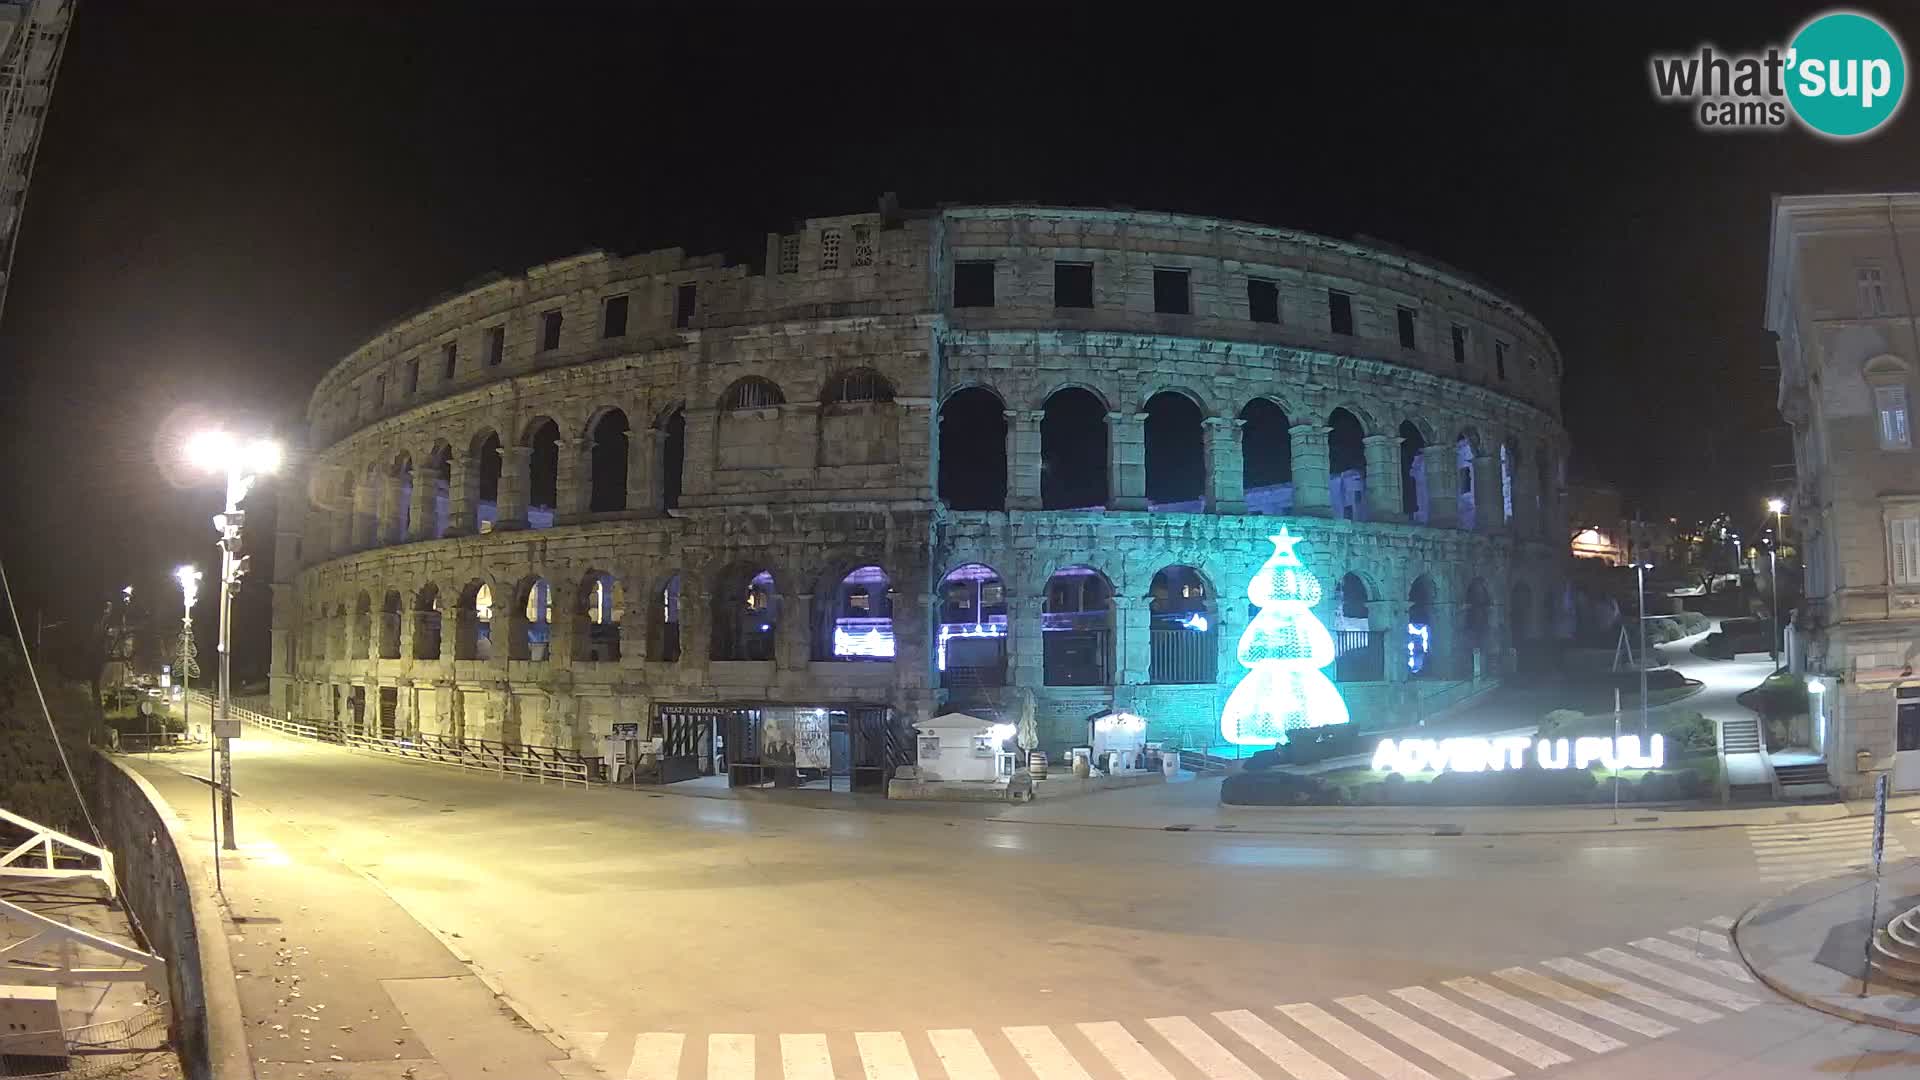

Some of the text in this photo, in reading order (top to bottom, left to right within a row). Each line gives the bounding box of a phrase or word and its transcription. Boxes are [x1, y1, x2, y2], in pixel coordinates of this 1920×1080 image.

[1371, 732, 1665, 772] ADVENT U PULI
